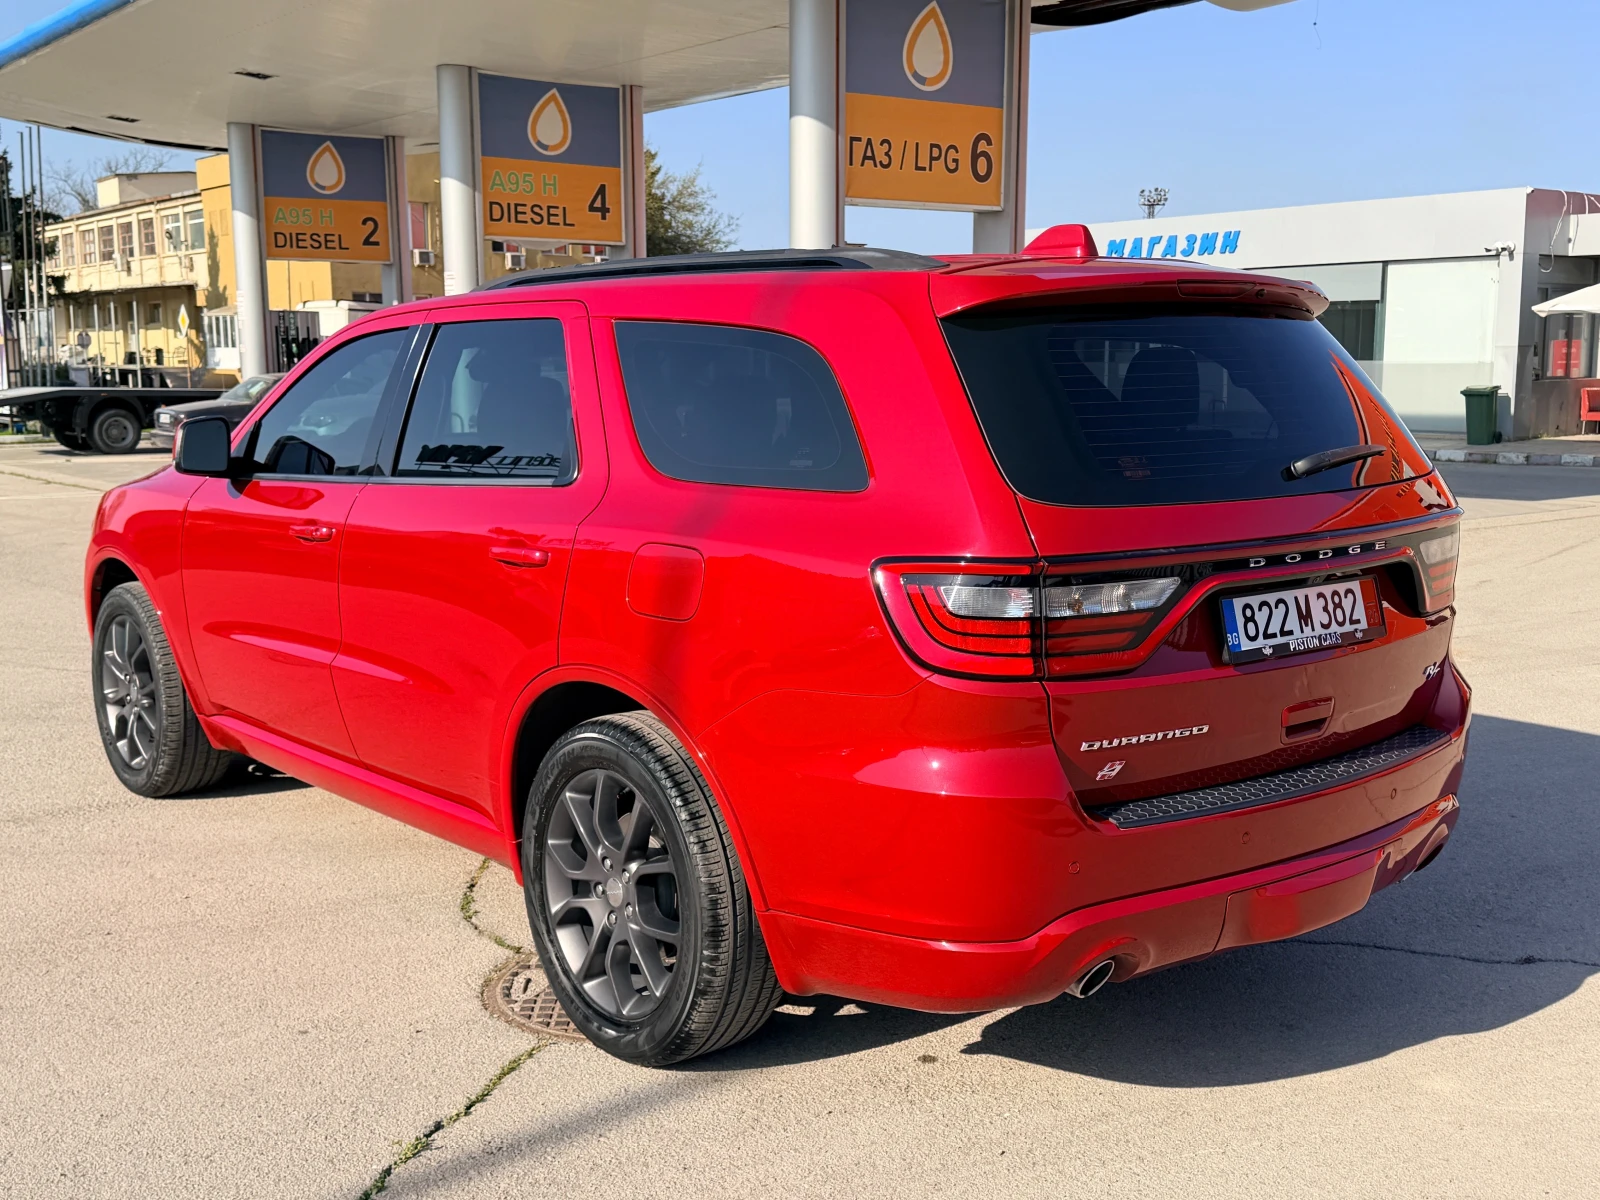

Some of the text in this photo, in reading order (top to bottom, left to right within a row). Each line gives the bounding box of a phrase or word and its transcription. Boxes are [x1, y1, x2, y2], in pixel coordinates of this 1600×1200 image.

[848, 136, 893, 168] ГАЗ
[914, 142, 960, 174] LPG
[970, 132, 994, 184] 6
[489, 170, 535, 195] A95
[488, 201, 576, 228] DIESEL
[588, 183, 611, 221] 4
[273, 207, 313, 226] A95
[273, 231, 350, 251] DIESEL
[361, 216, 381, 247] 2
[1106, 229, 1242, 258] МАГАЗИН
[1249, 540, 1388, 568] DODGE
[1241, 587, 1362, 643] 822 M 382
[1289, 632, 1342, 652] PISTON CARS
[1080, 724, 1210, 752] DURANGO
